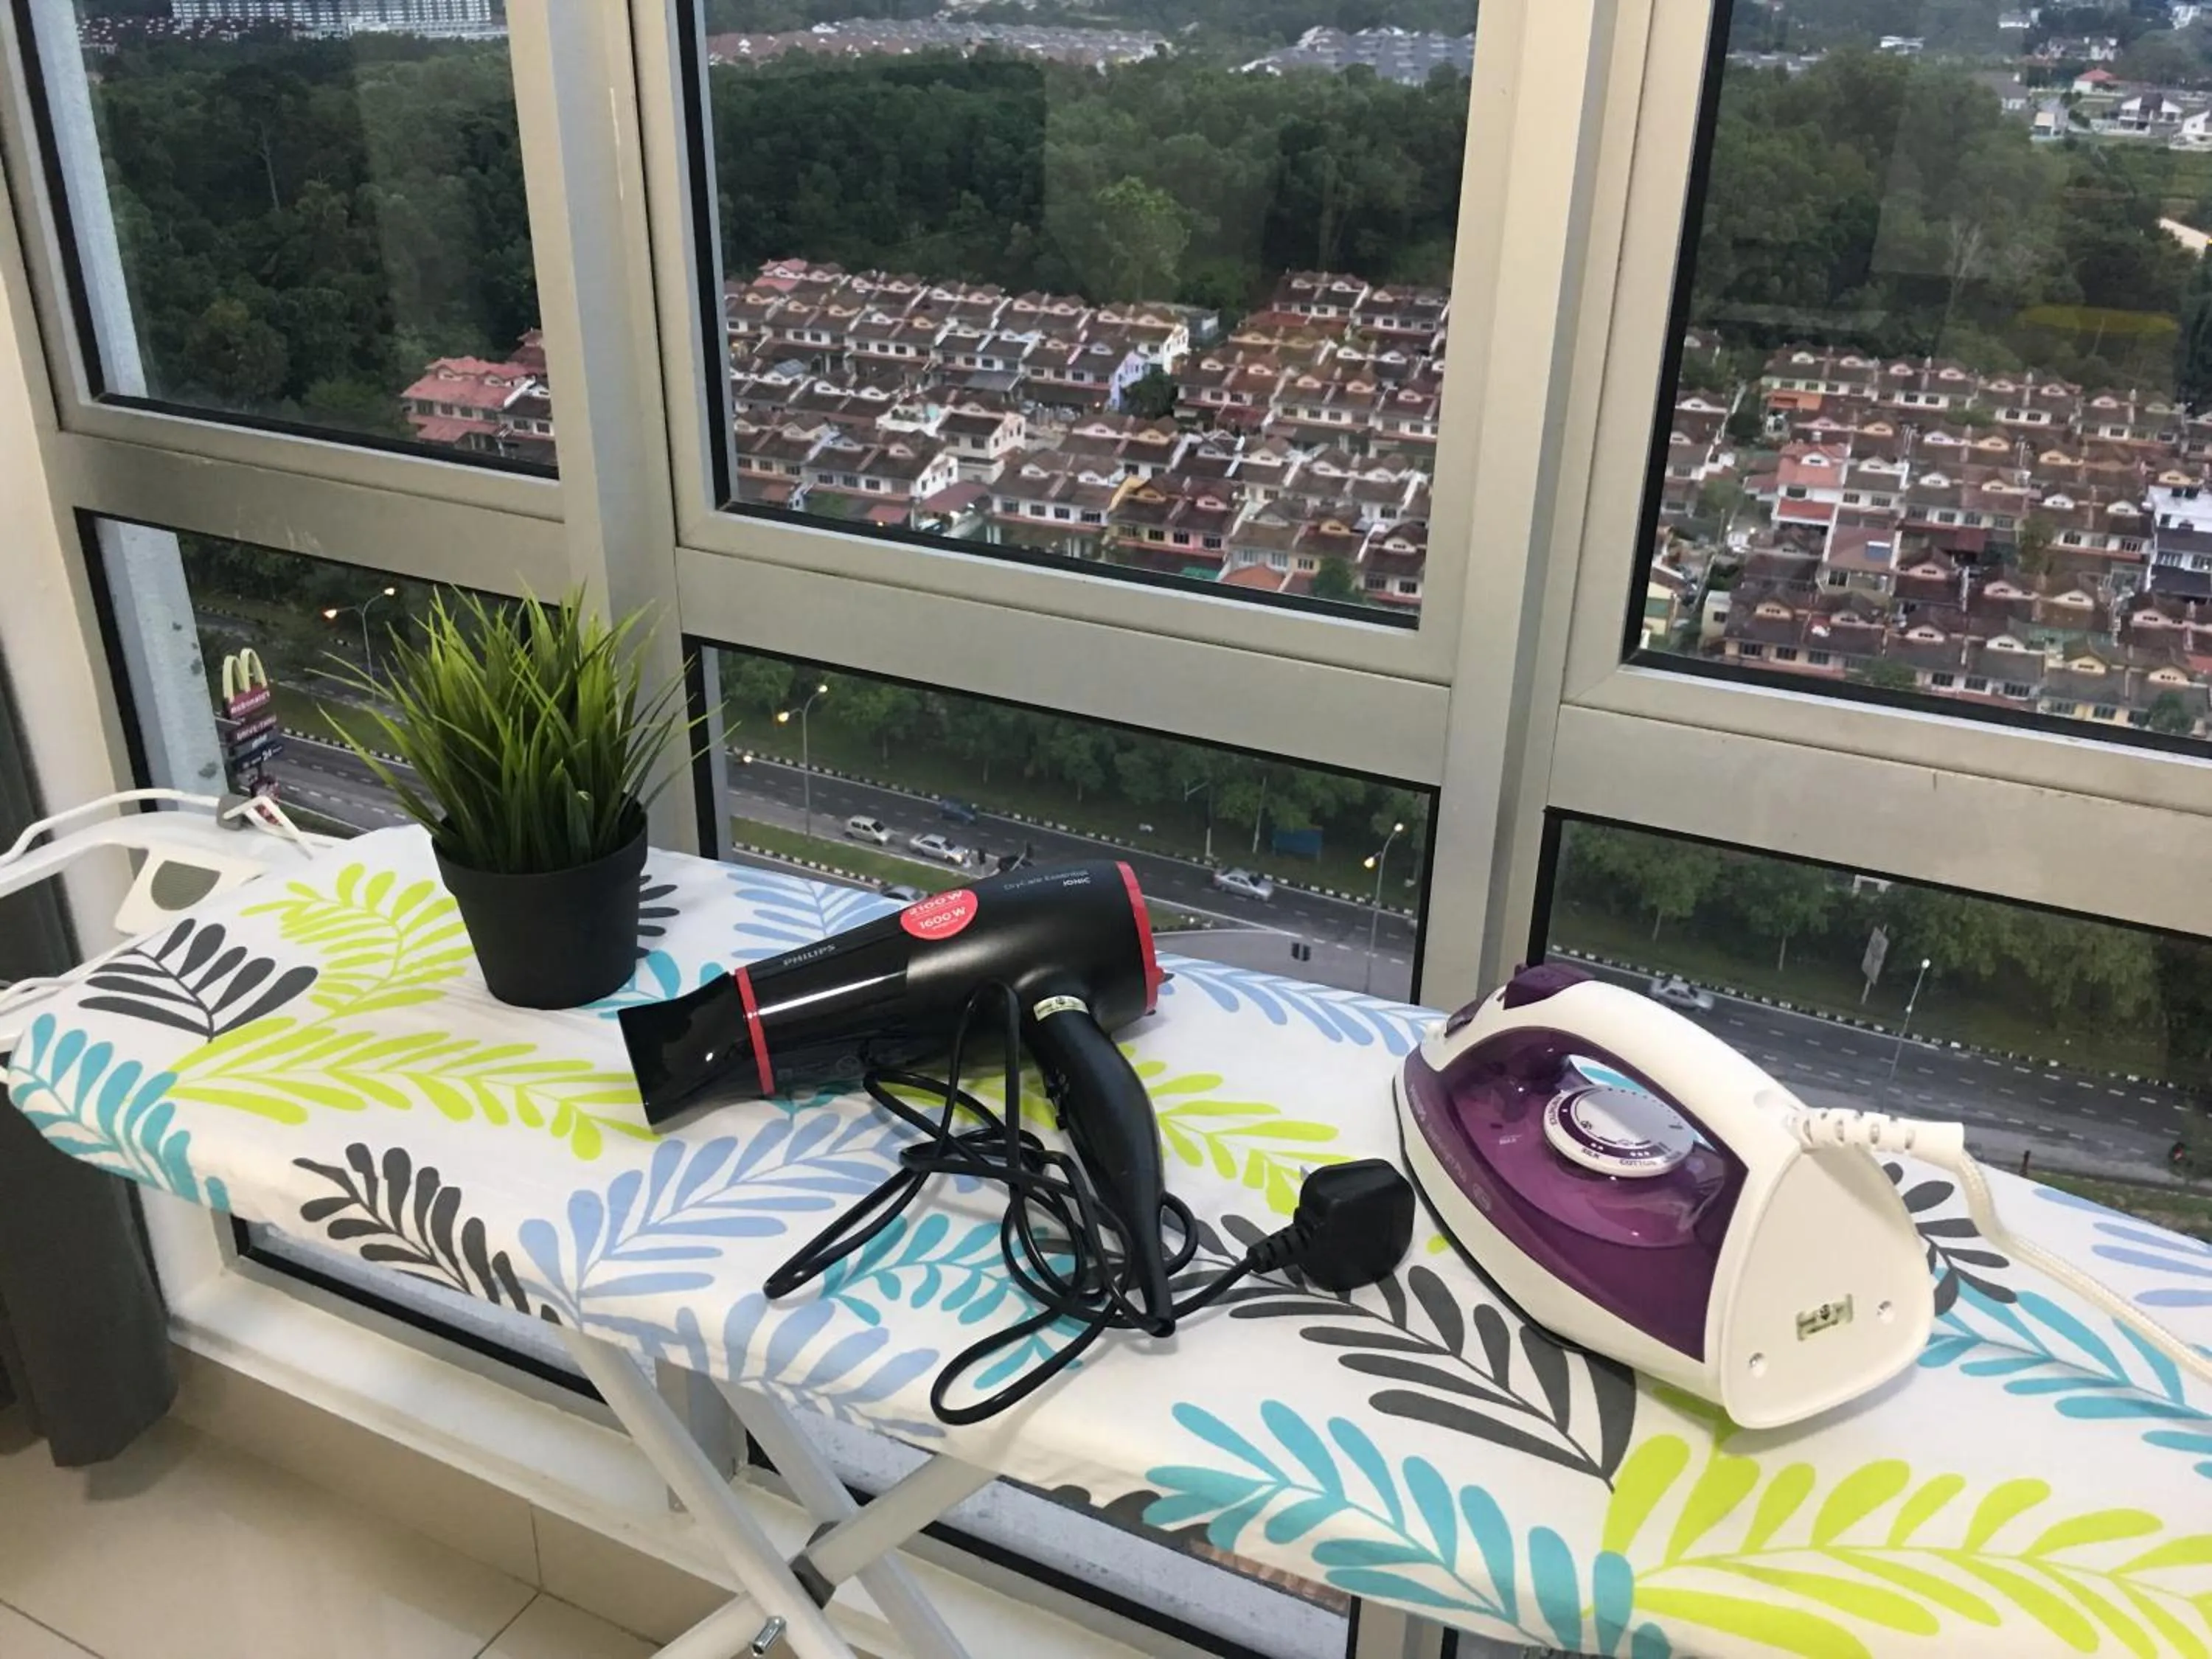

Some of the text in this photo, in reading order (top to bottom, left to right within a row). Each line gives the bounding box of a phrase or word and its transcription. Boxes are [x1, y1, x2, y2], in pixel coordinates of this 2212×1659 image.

[919, 913, 951, 929] 1600
[952, 906, 965, 917] W
[783, 944, 835, 966] PHILIPS
